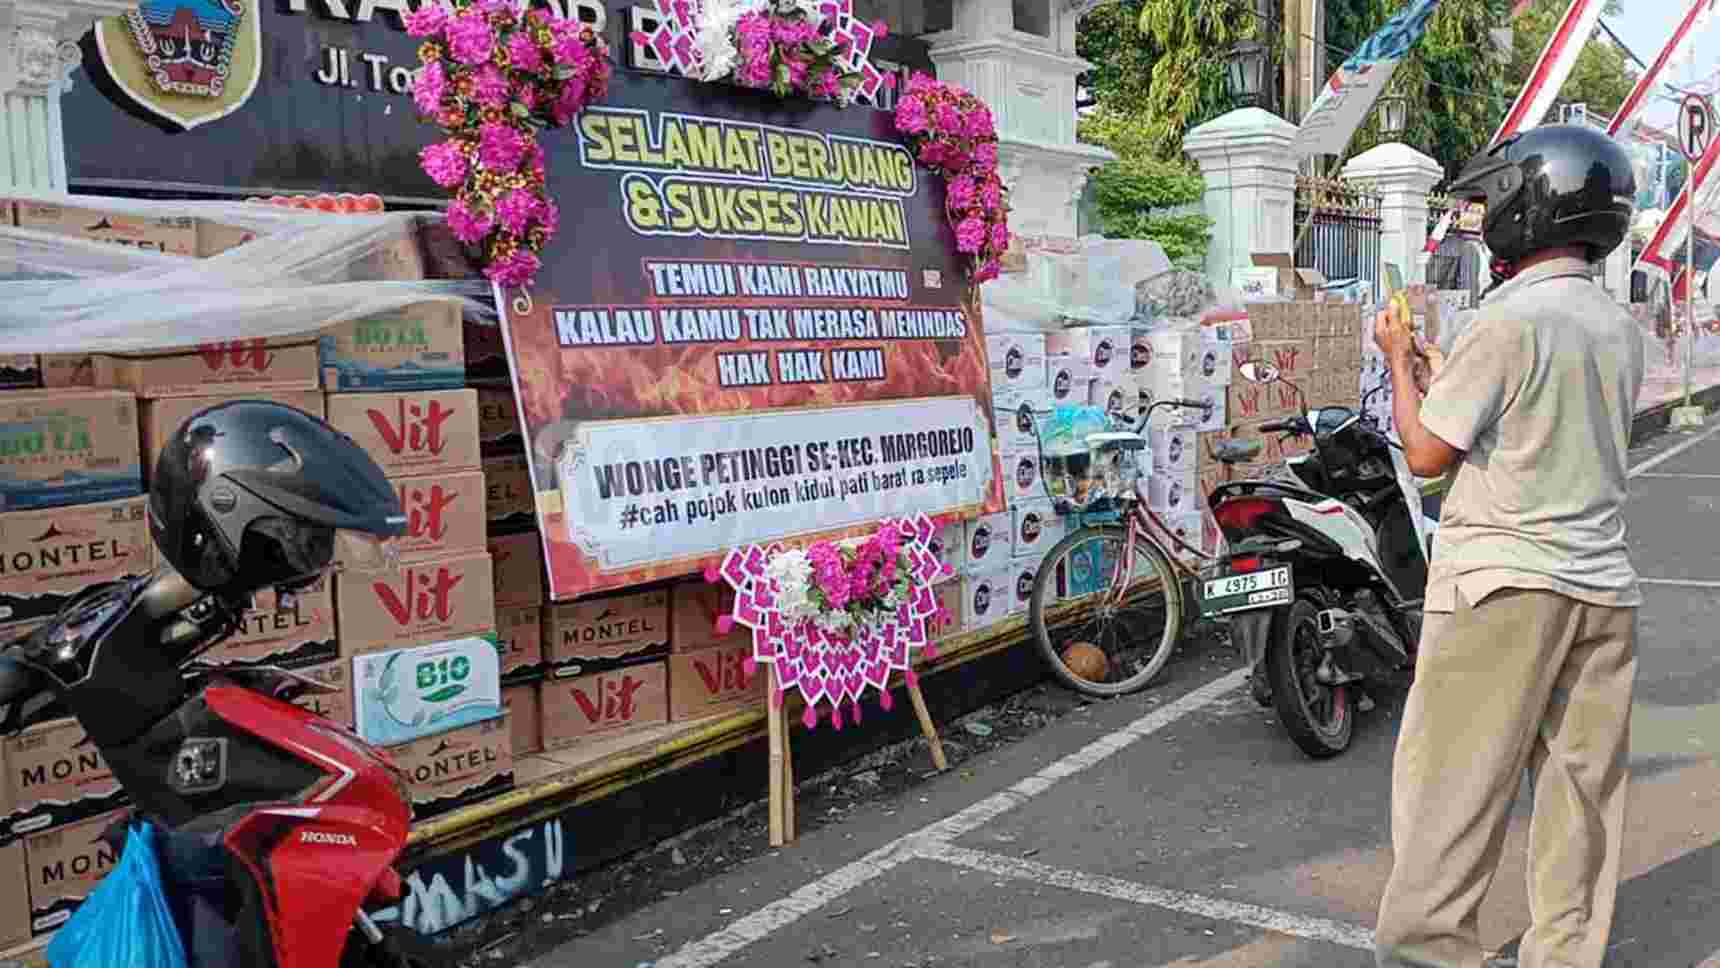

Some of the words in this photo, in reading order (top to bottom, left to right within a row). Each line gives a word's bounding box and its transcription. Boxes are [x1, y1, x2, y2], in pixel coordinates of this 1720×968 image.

[581, 114, 762, 172] SELAMAT
[768, 134, 914, 190] BERJUANG
[667, 182, 803, 234] SUKSES
[806, 194, 905, 241] KAWAN
[649, 263, 736, 296] TEMUI
[738, 266, 800, 297] KAMI
[804, 267, 909, 299] RAKYATMU
[554, 310, 656, 345] KALAU
[660, 309, 742, 342] KAMU
[744, 309, 792, 340] TAK
[793, 310, 879, 339] MERASA
[880, 311, 967, 338] MENINDAS
[719, 352, 770, 386] HAK
[778, 351, 825, 383] HAK
[832, 350, 884, 381] KAMI
[366, 400, 454, 456] Vit
[593, 459, 697, 499] WONGE
[701, 446, 803, 485] PETINGGI
[806, 437, 878, 472] SE-KEC.
[880, 427, 974, 464] MARGOREJO
[619, 499, 679, 530] #cah
[687, 490, 737, 525] pojok
[742, 485, 791, 511] kulon
[795, 477, 835, 503] kidul
[840, 472, 869, 501] pati
[872, 468, 908, 491] barat
[911, 468, 925, 486] ra
[927, 459, 968, 486] sepele
[0, 539, 129, 574] ONTEL
[371, 566, 465, 626] Vit
[563, 618, 655, 645] MONTEL
[570, 674, 645, 724] Vit
[21, 751, 98, 787] MON
[300, 830, 357, 847] HONDA
[41, 848, 117, 885] MON
